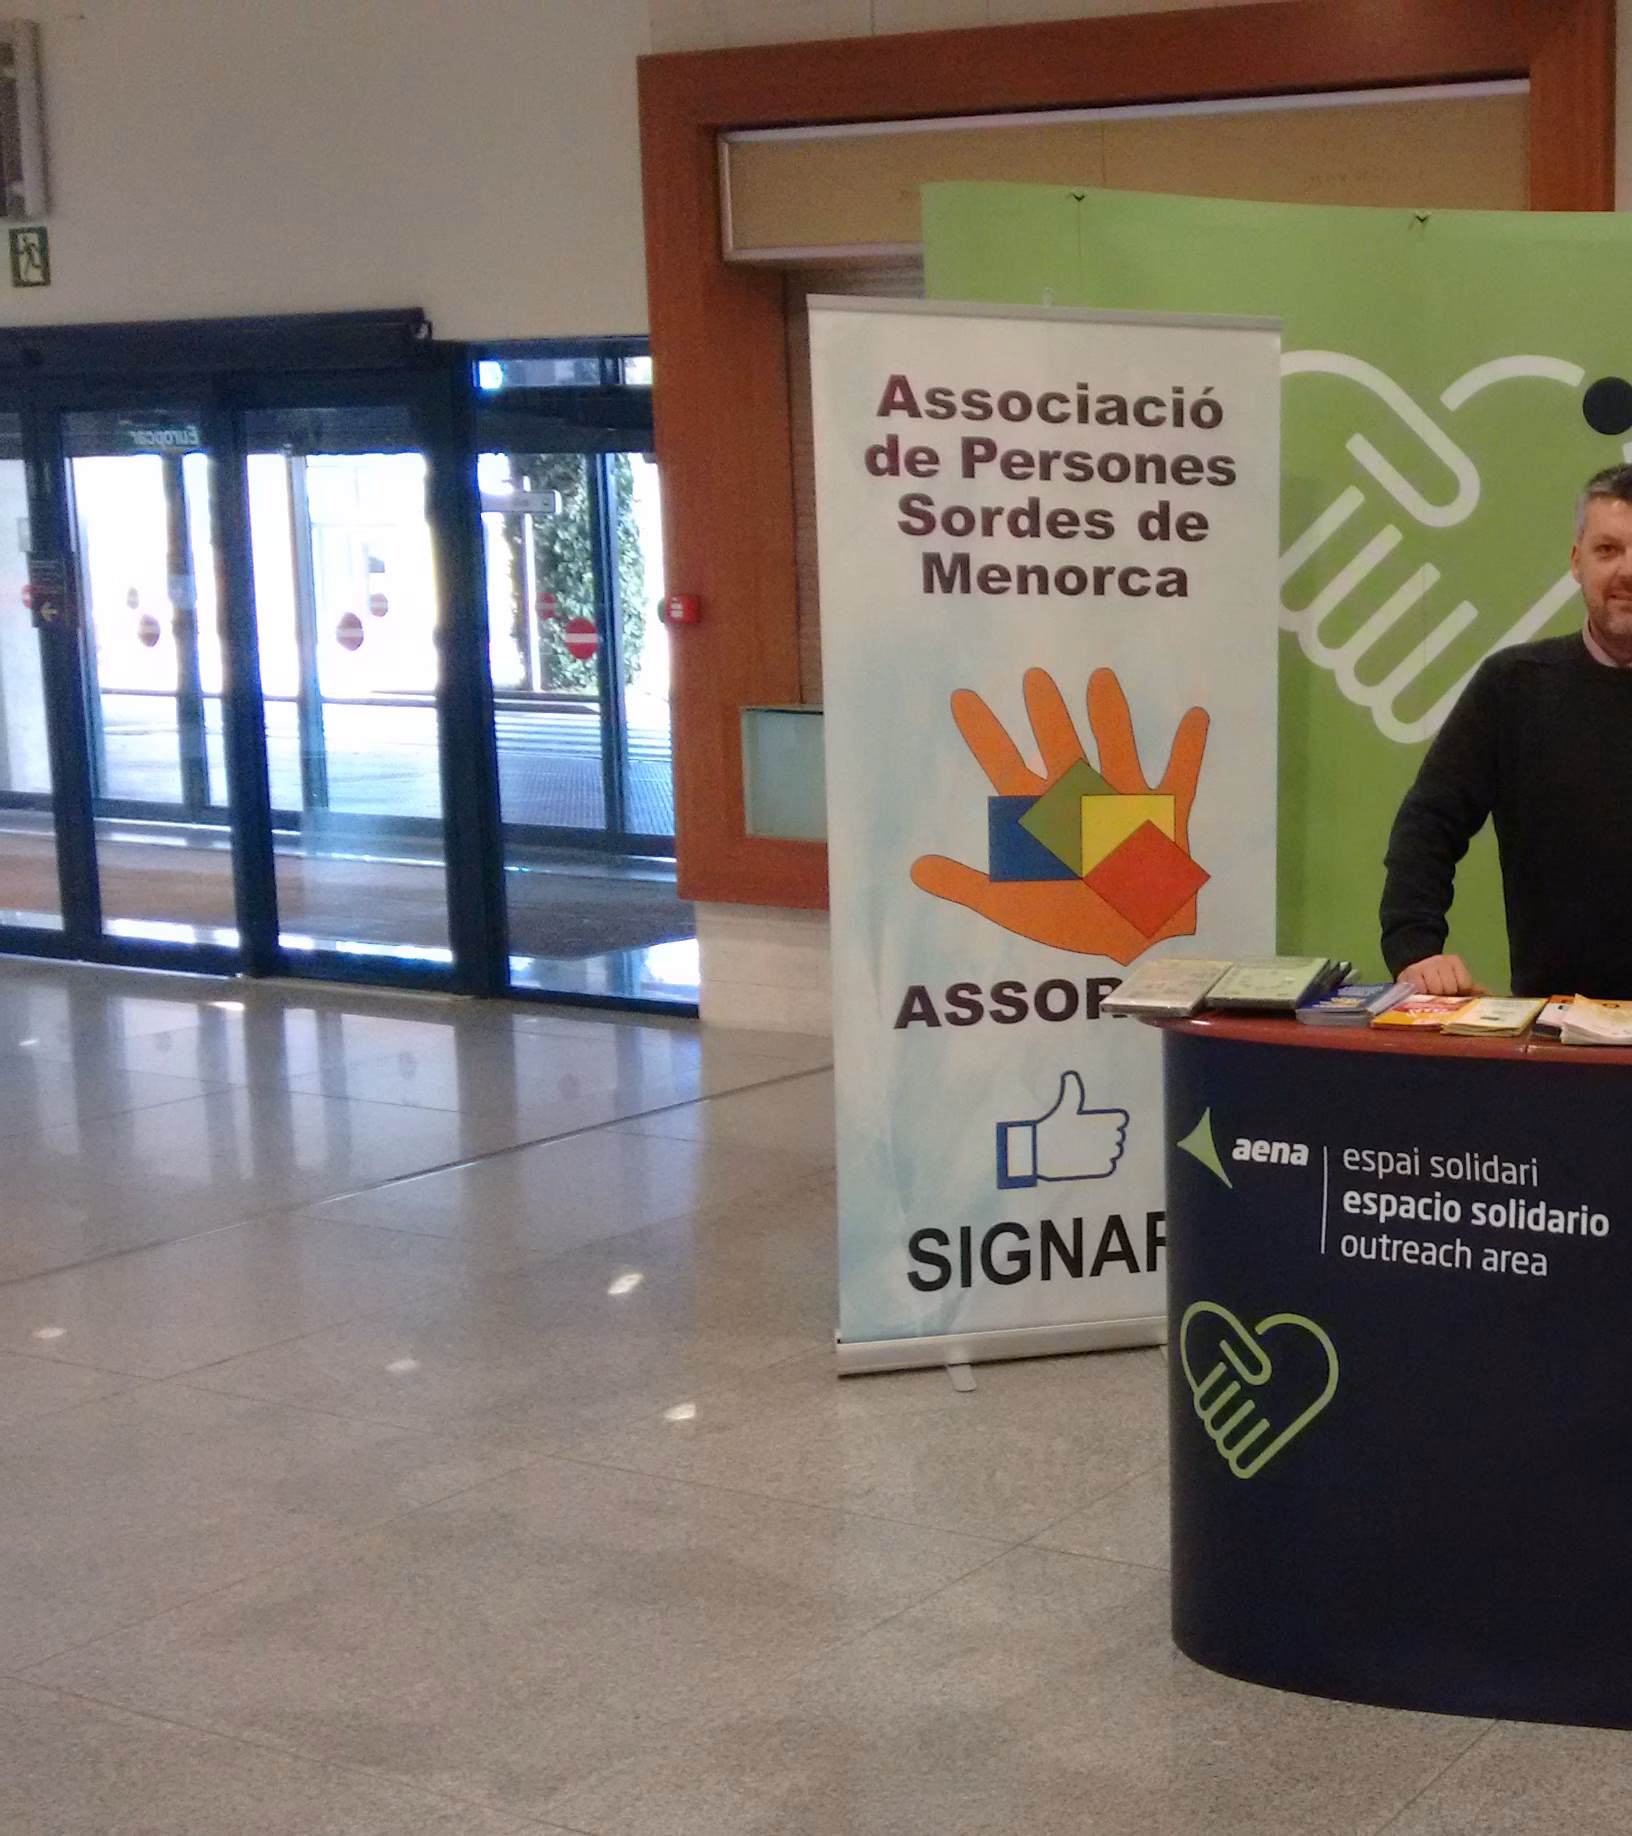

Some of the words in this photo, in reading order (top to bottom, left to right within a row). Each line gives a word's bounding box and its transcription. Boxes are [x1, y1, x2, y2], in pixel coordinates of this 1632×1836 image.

[876, 374, 1224, 429] Associació
[864, 434, 940, 478] de
[961, 436, 1237, 486] Persones
[897, 493, 1115, 540] Sordes
[1137, 500, 1210, 541] de
[922, 552, 1189, 598] Menorca
[1231, 1137, 1310, 1166] aena
[1343, 1147, 1421, 1180] espai
[1430, 1152, 1540, 1187] solidari
[1342, 1190, 1462, 1223] espacio
[1471, 1198, 1611, 1237] solidario
[1340, 1232, 1473, 1270] outreach
[1482, 1248, 1549, 1277] area
